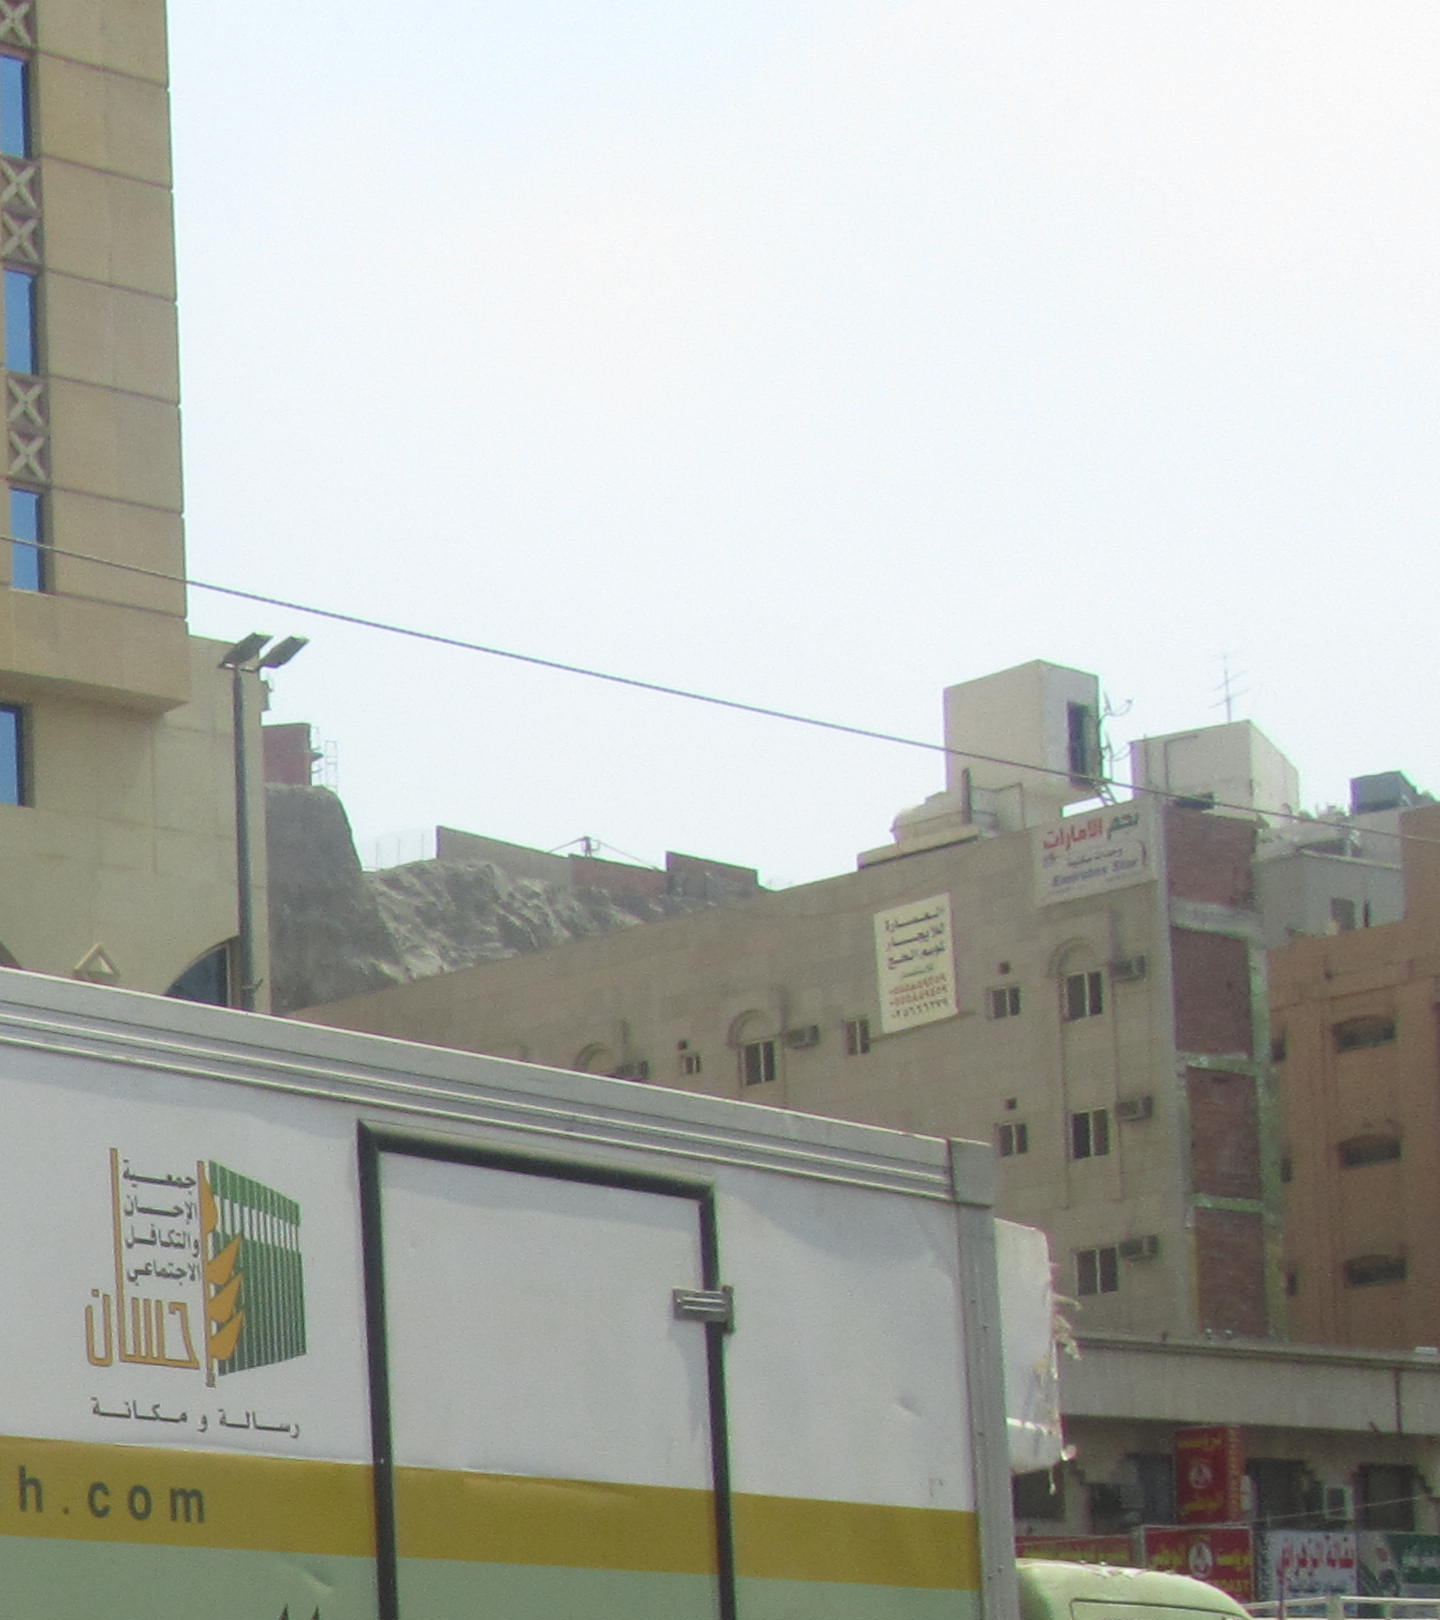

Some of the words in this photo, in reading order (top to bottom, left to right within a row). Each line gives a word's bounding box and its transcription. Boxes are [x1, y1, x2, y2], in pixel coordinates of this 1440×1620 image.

[122, 1159, 197, 1195] جمعية
[124, 1195, 197, 1225] الإحسان
[125, 1224, 200, 1258] والتكافل
[91, 1397, 188, 1423] مكانة
[217, 1409, 300, 1439] رسالة
